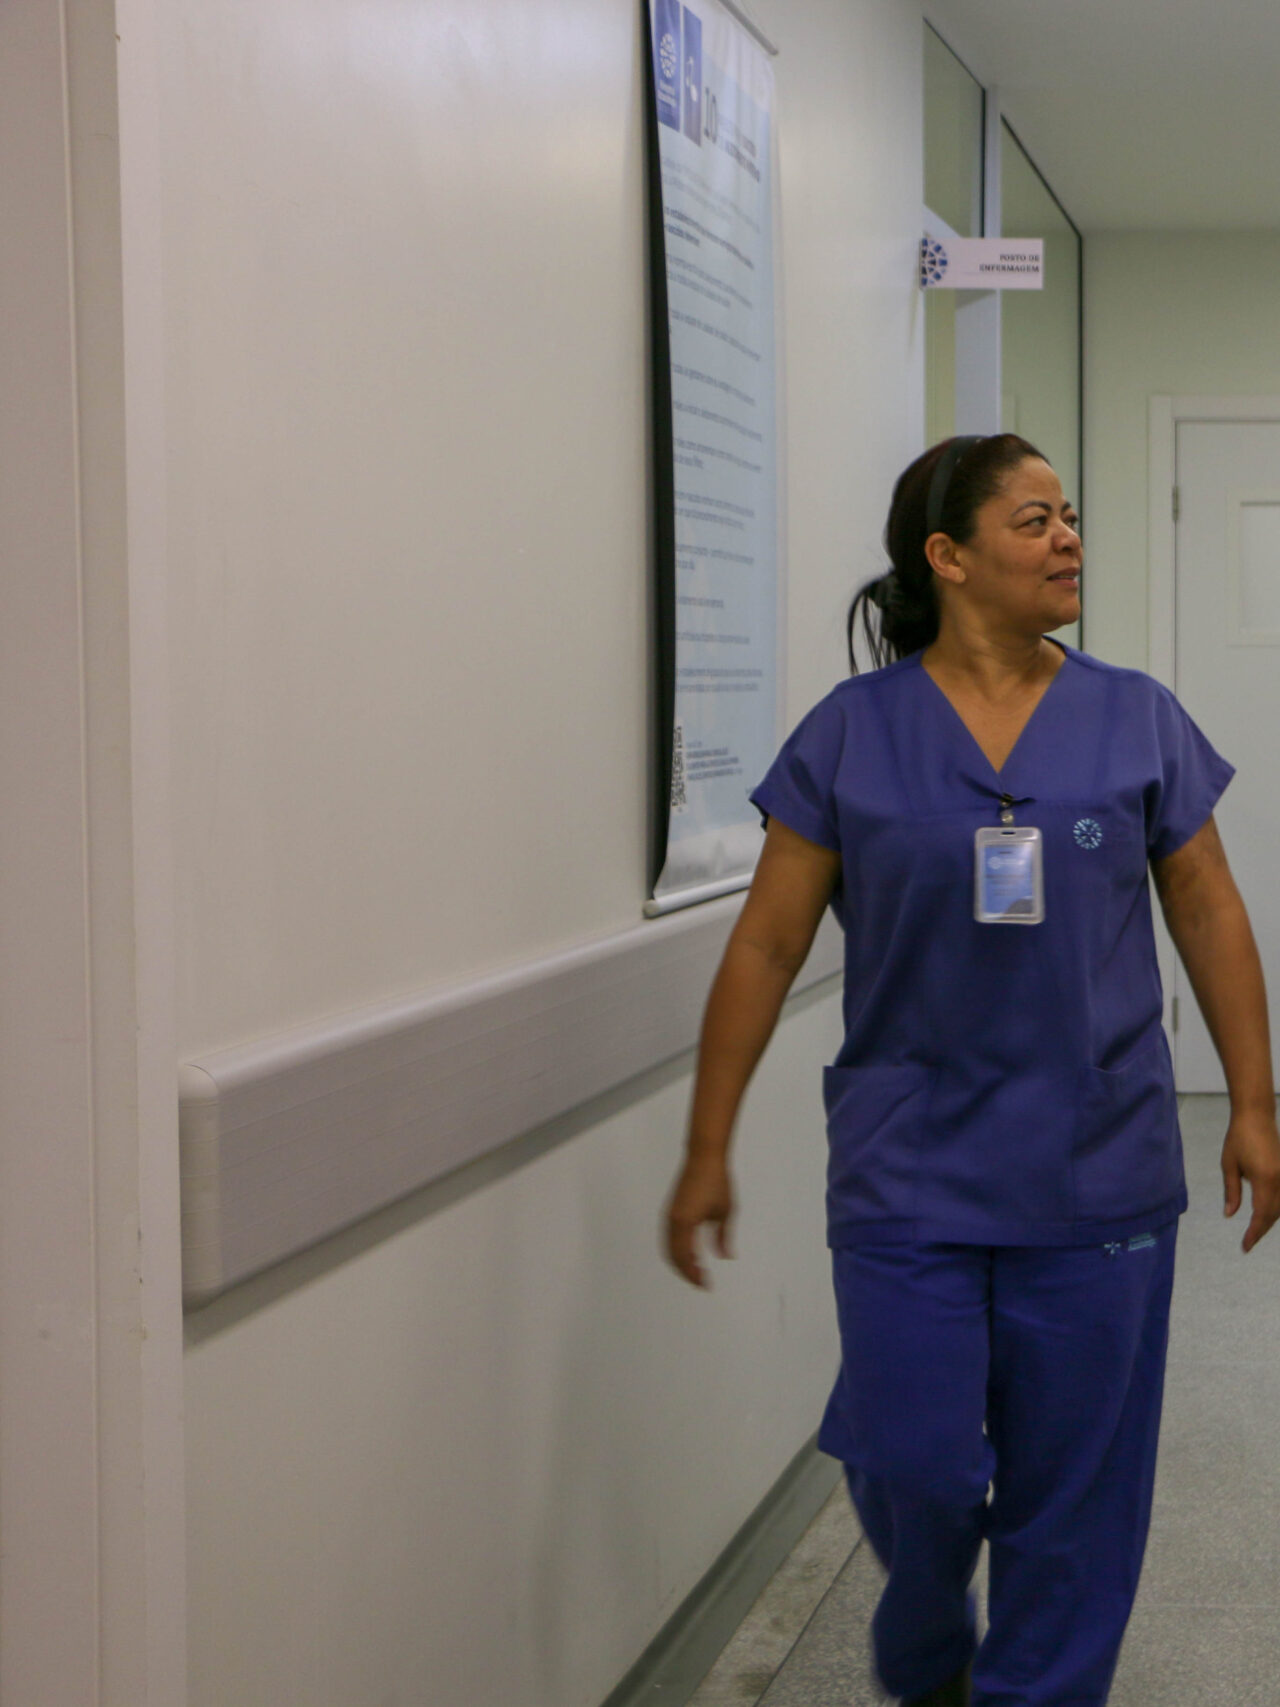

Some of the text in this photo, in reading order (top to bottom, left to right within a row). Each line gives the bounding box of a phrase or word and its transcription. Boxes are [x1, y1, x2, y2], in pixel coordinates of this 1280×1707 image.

[999, 254, 1040, 262] POSTO DE
[979, 263, 1040, 273] ENFERMAGEM
